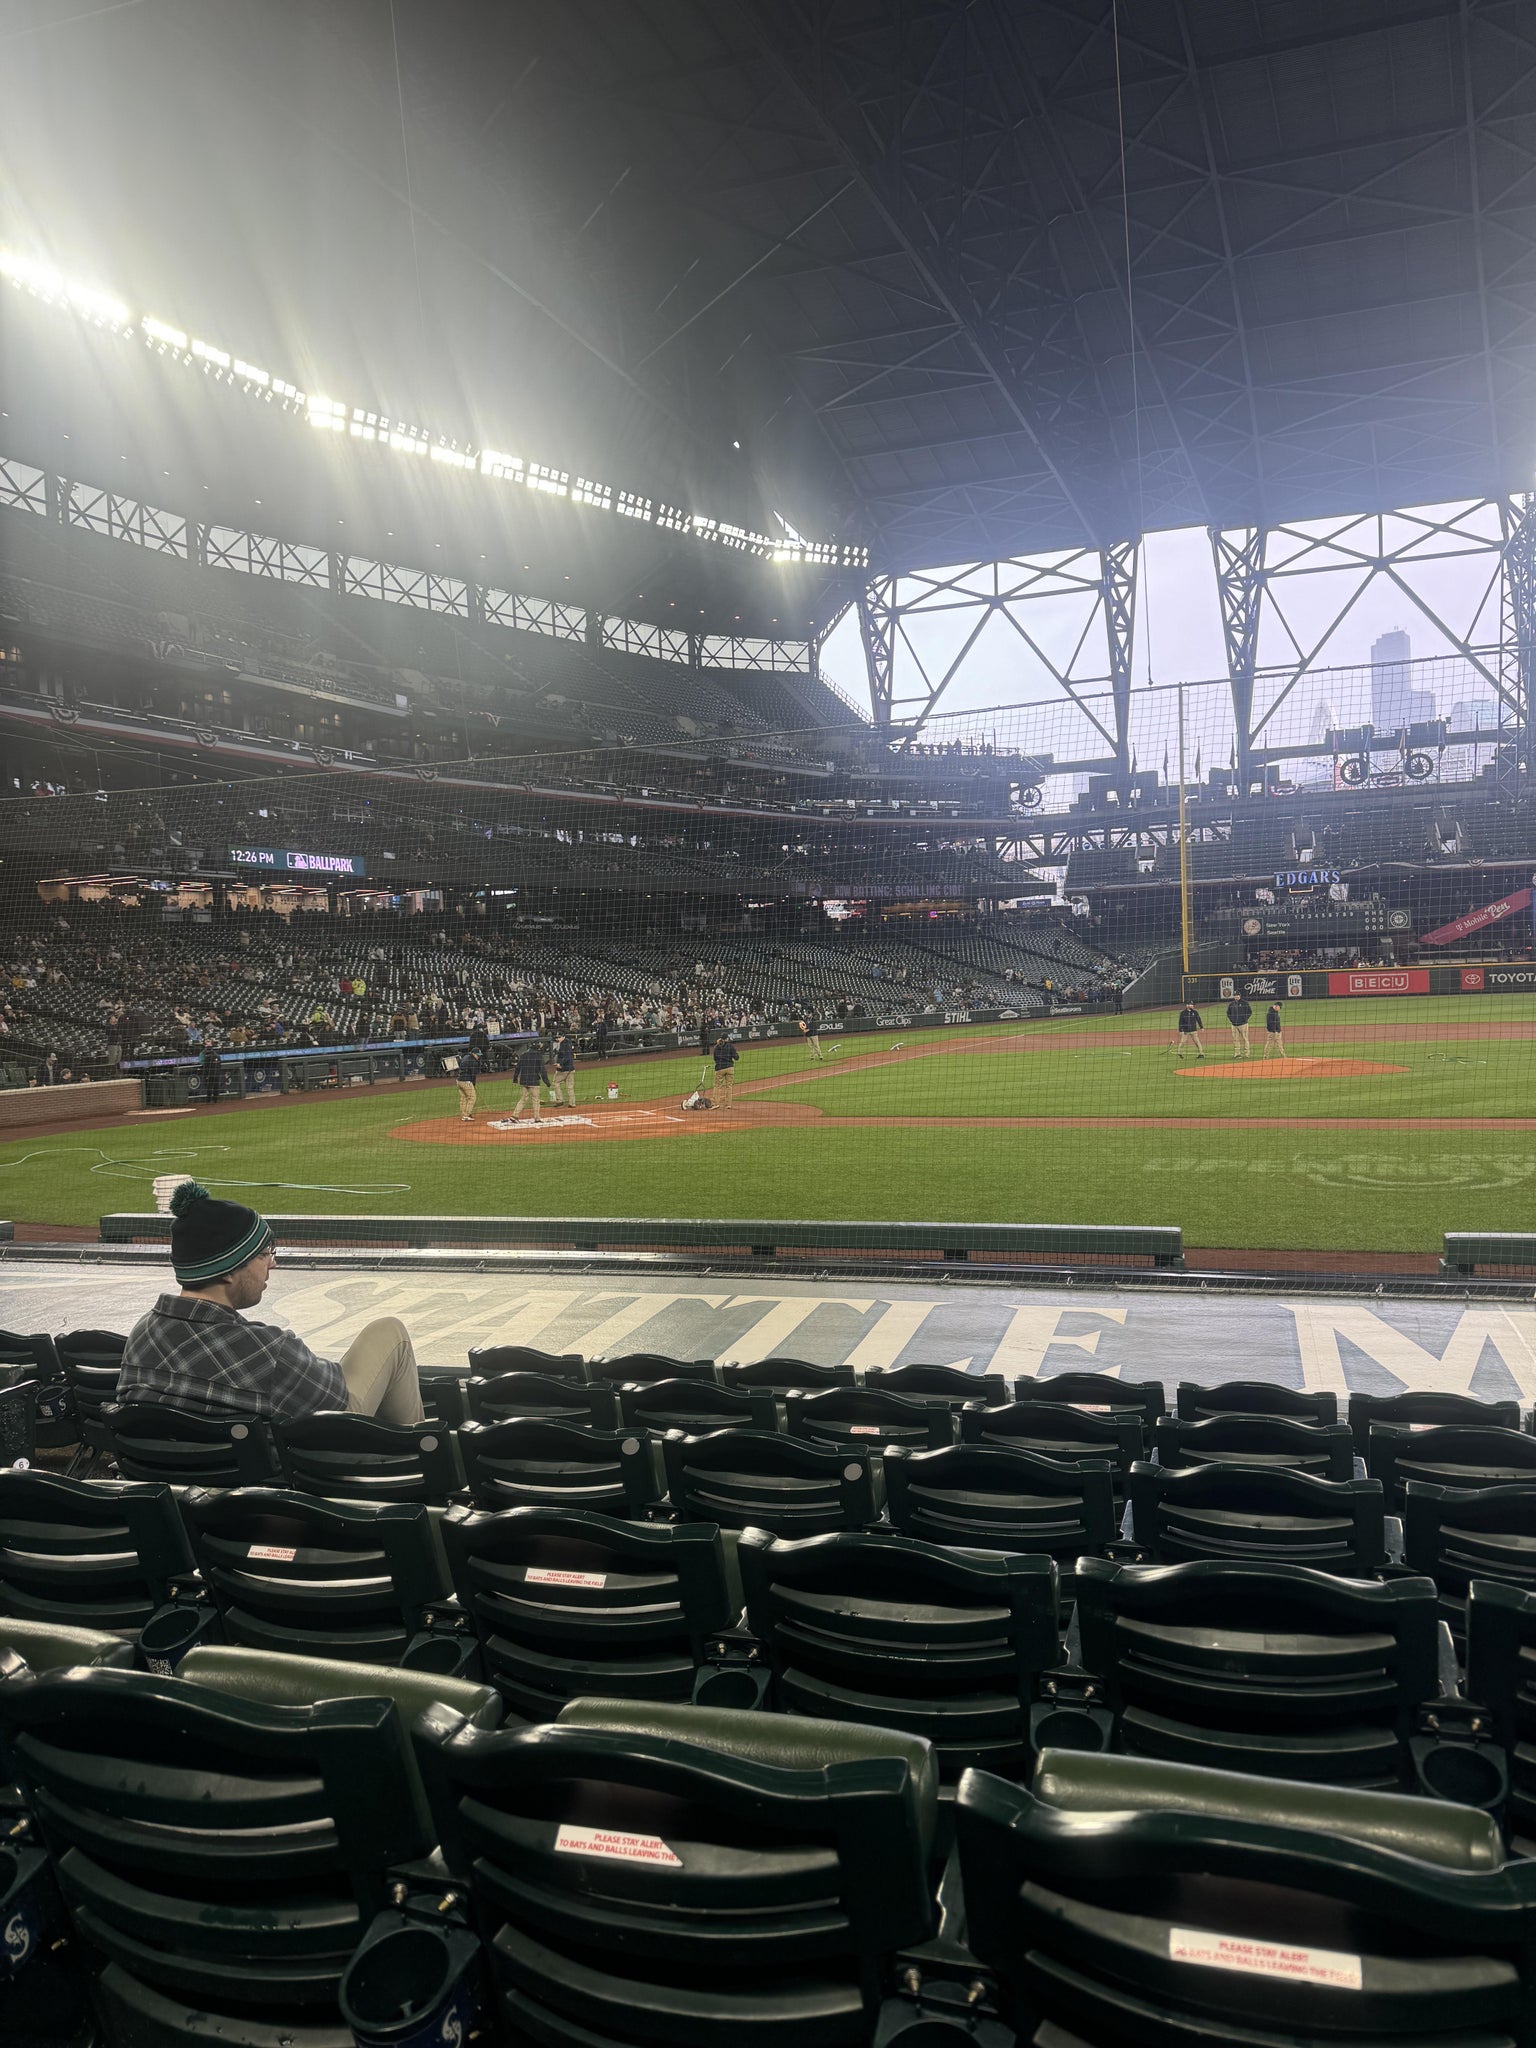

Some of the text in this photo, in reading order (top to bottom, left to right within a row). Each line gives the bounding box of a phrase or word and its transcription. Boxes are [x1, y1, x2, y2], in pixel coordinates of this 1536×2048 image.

[231, 850, 274, 864] 12:26 PM
[309, 855, 354, 872] BALLPARK
[1276, 871, 1340, 886] EDGAR'S
[834, 885, 851, 896] NOW
[854, 885, 893, 896] BATTING:
[1464, 913, 1488, 929] Mobile
[876, 1016, 912, 1027] Great Clips
[944, 1011, 971, 1023] STIHL
[594, 1833, 663, 1849] PLEASE STAY ALERT
[570, 1840, 587, 1849] BATS
[588, 1843, 604, 1851] AND
[605, 1844, 628, 1854] BALLS
[628, 1848, 659, 1859] LEAVING
[661, 1852, 675, 1861] THE
[1219, 1940, 1309, 1962] PLEASE STAY ALERT
